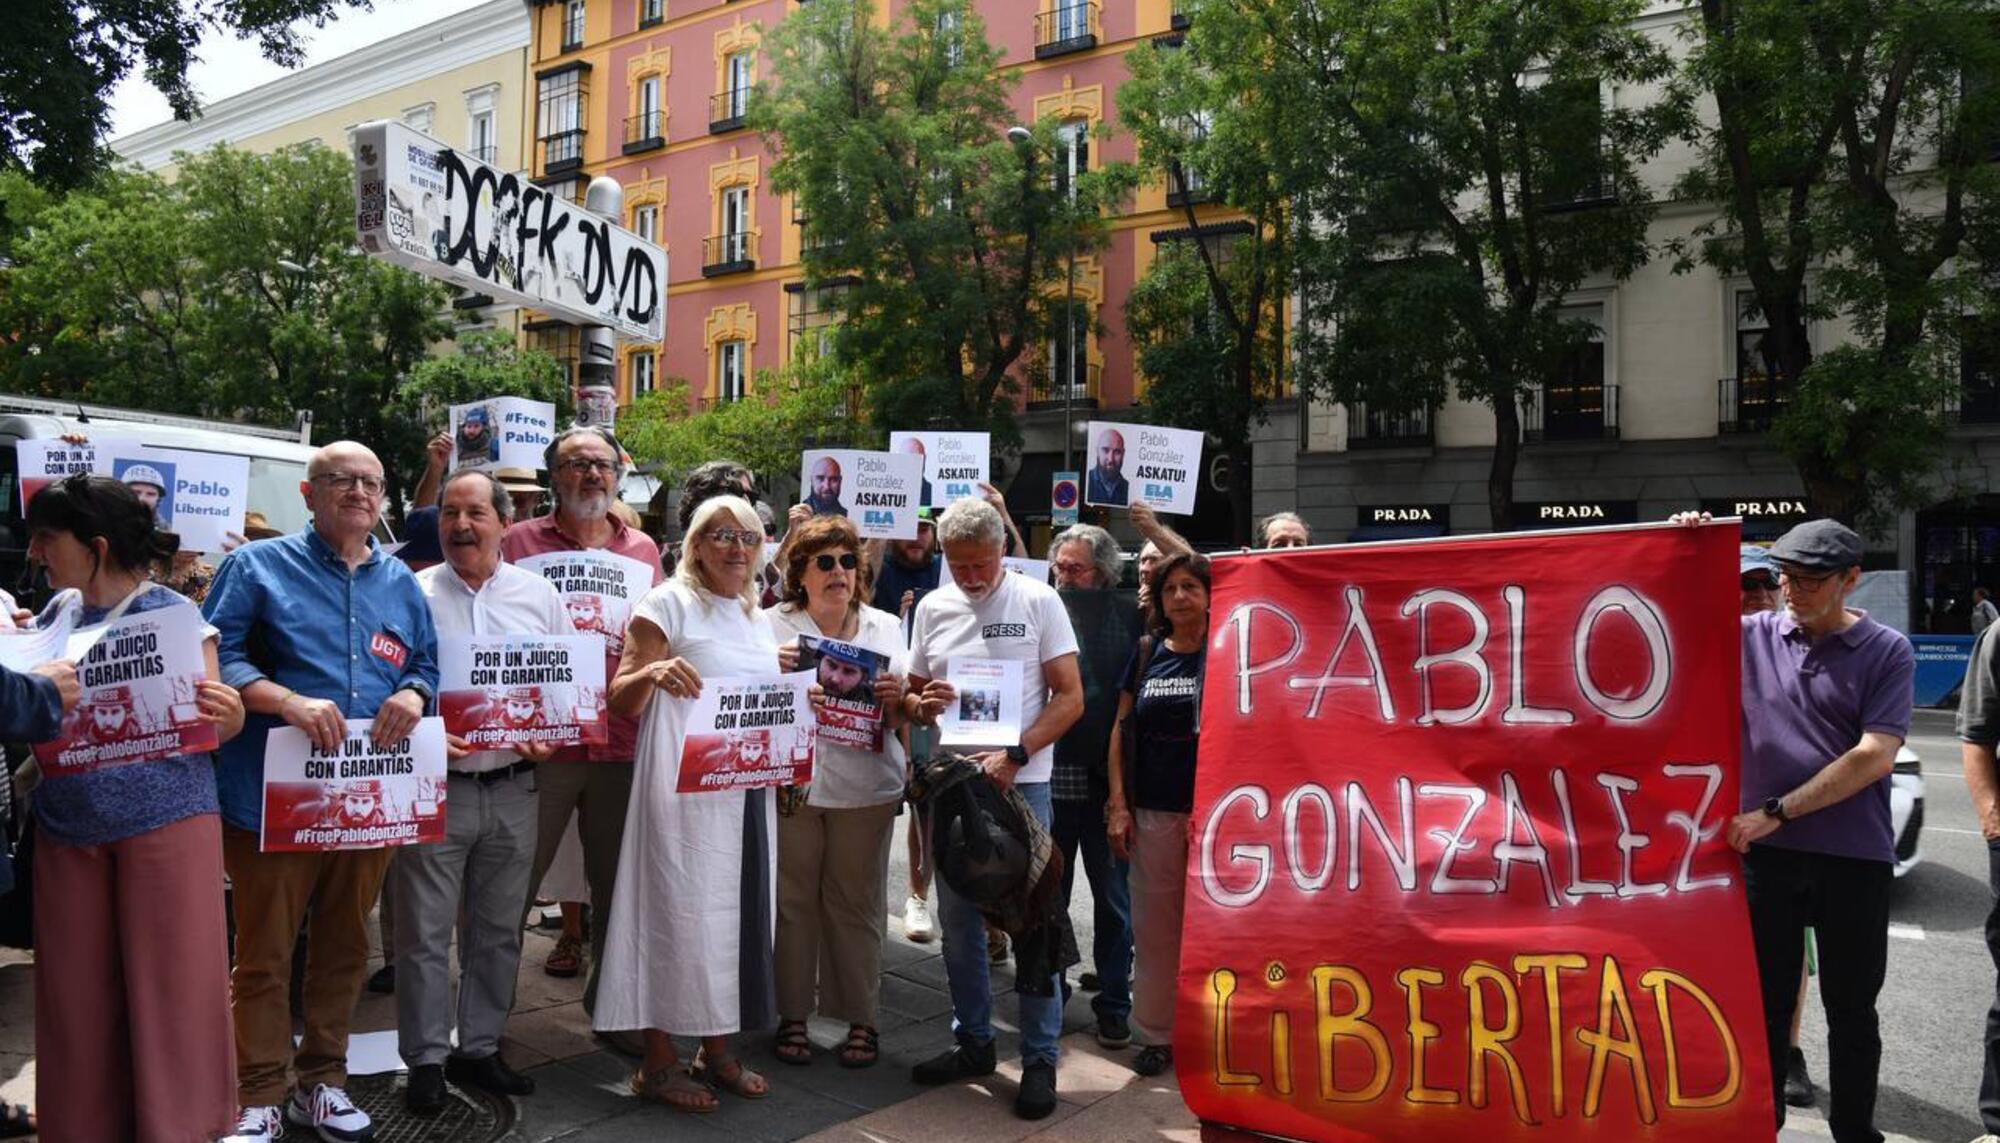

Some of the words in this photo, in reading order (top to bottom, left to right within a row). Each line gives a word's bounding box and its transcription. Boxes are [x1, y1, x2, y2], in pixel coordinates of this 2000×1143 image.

[505, 412, 547, 428] #Free
[505, 431, 550, 445] Pablo
[937, 437, 962, 450] Pablo
[1140, 431, 1169, 446] Pablo
[46, 450, 67, 462] POR
[70, 451, 82, 461] UN
[857, 457, 887, 472] Pablo
[937, 451, 977, 465] González
[1138, 447, 1184, 465] González
[44, 463, 65, 474] CON
[937, 467, 980, 480] ASKATU!
[1136, 465, 1186, 482] ASKATU!
[176, 479, 230, 497] Pablo
[856, 474, 904, 490] González
[945, 483, 972, 496] ELA
[1145, 483, 1173, 498] ELA
[855, 492, 907, 508] ASKATU!
[1735, 501, 1807, 516] PRADA
[175, 503, 230, 517] Libertad
[864, 510, 895, 524] ELA
[1374, 508, 1432, 521] PRADA
[1540, 505, 1605, 519] PRADA
[543, 565, 566, 579] POR
[569, 564, 585, 578] UN
[588, 566, 625, 584] JUICIO
[565, 579, 628, 599] GARANTÍAS
[983, 626, 1025, 637] PRESS
[88, 645, 107, 664] UN
[112, 633, 158, 660] JUICIO
[372, 634, 401, 660] UGT
[828, 641, 859, 658] PRESS
[1214, 584, 1674, 727] PABLO
[475, 652, 501, 667] POR
[505, 651, 523, 667] UN
[526, 650, 569, 666] JUICIO
[85, 655, 165, 688] GARANTÍAS
[470, 670, 497, 685] CON
[502, 666, 573, 685] GARANTÍAS
[720, 695, 741, 711] POR
[744, 693, 759, 709] UN
[762, 691, 794, 709] JUICIO
[714, 713, 736, 729] CON
[740, 708, 795, 727] GARANTÍAS
[465, 726, 580, 744] #FreePabloGonzález
[58, 732, 182, 766] #FreePabloGonzález
[344, 739, 362, 757] UN
[305, 761, 335, 779] CON
[340, 755, 413, 778] GARANTÍAS
[294, 823, 419, 844] #FreePabloGonzález
[1201, 762, 1731, 909] GONZALEZ
